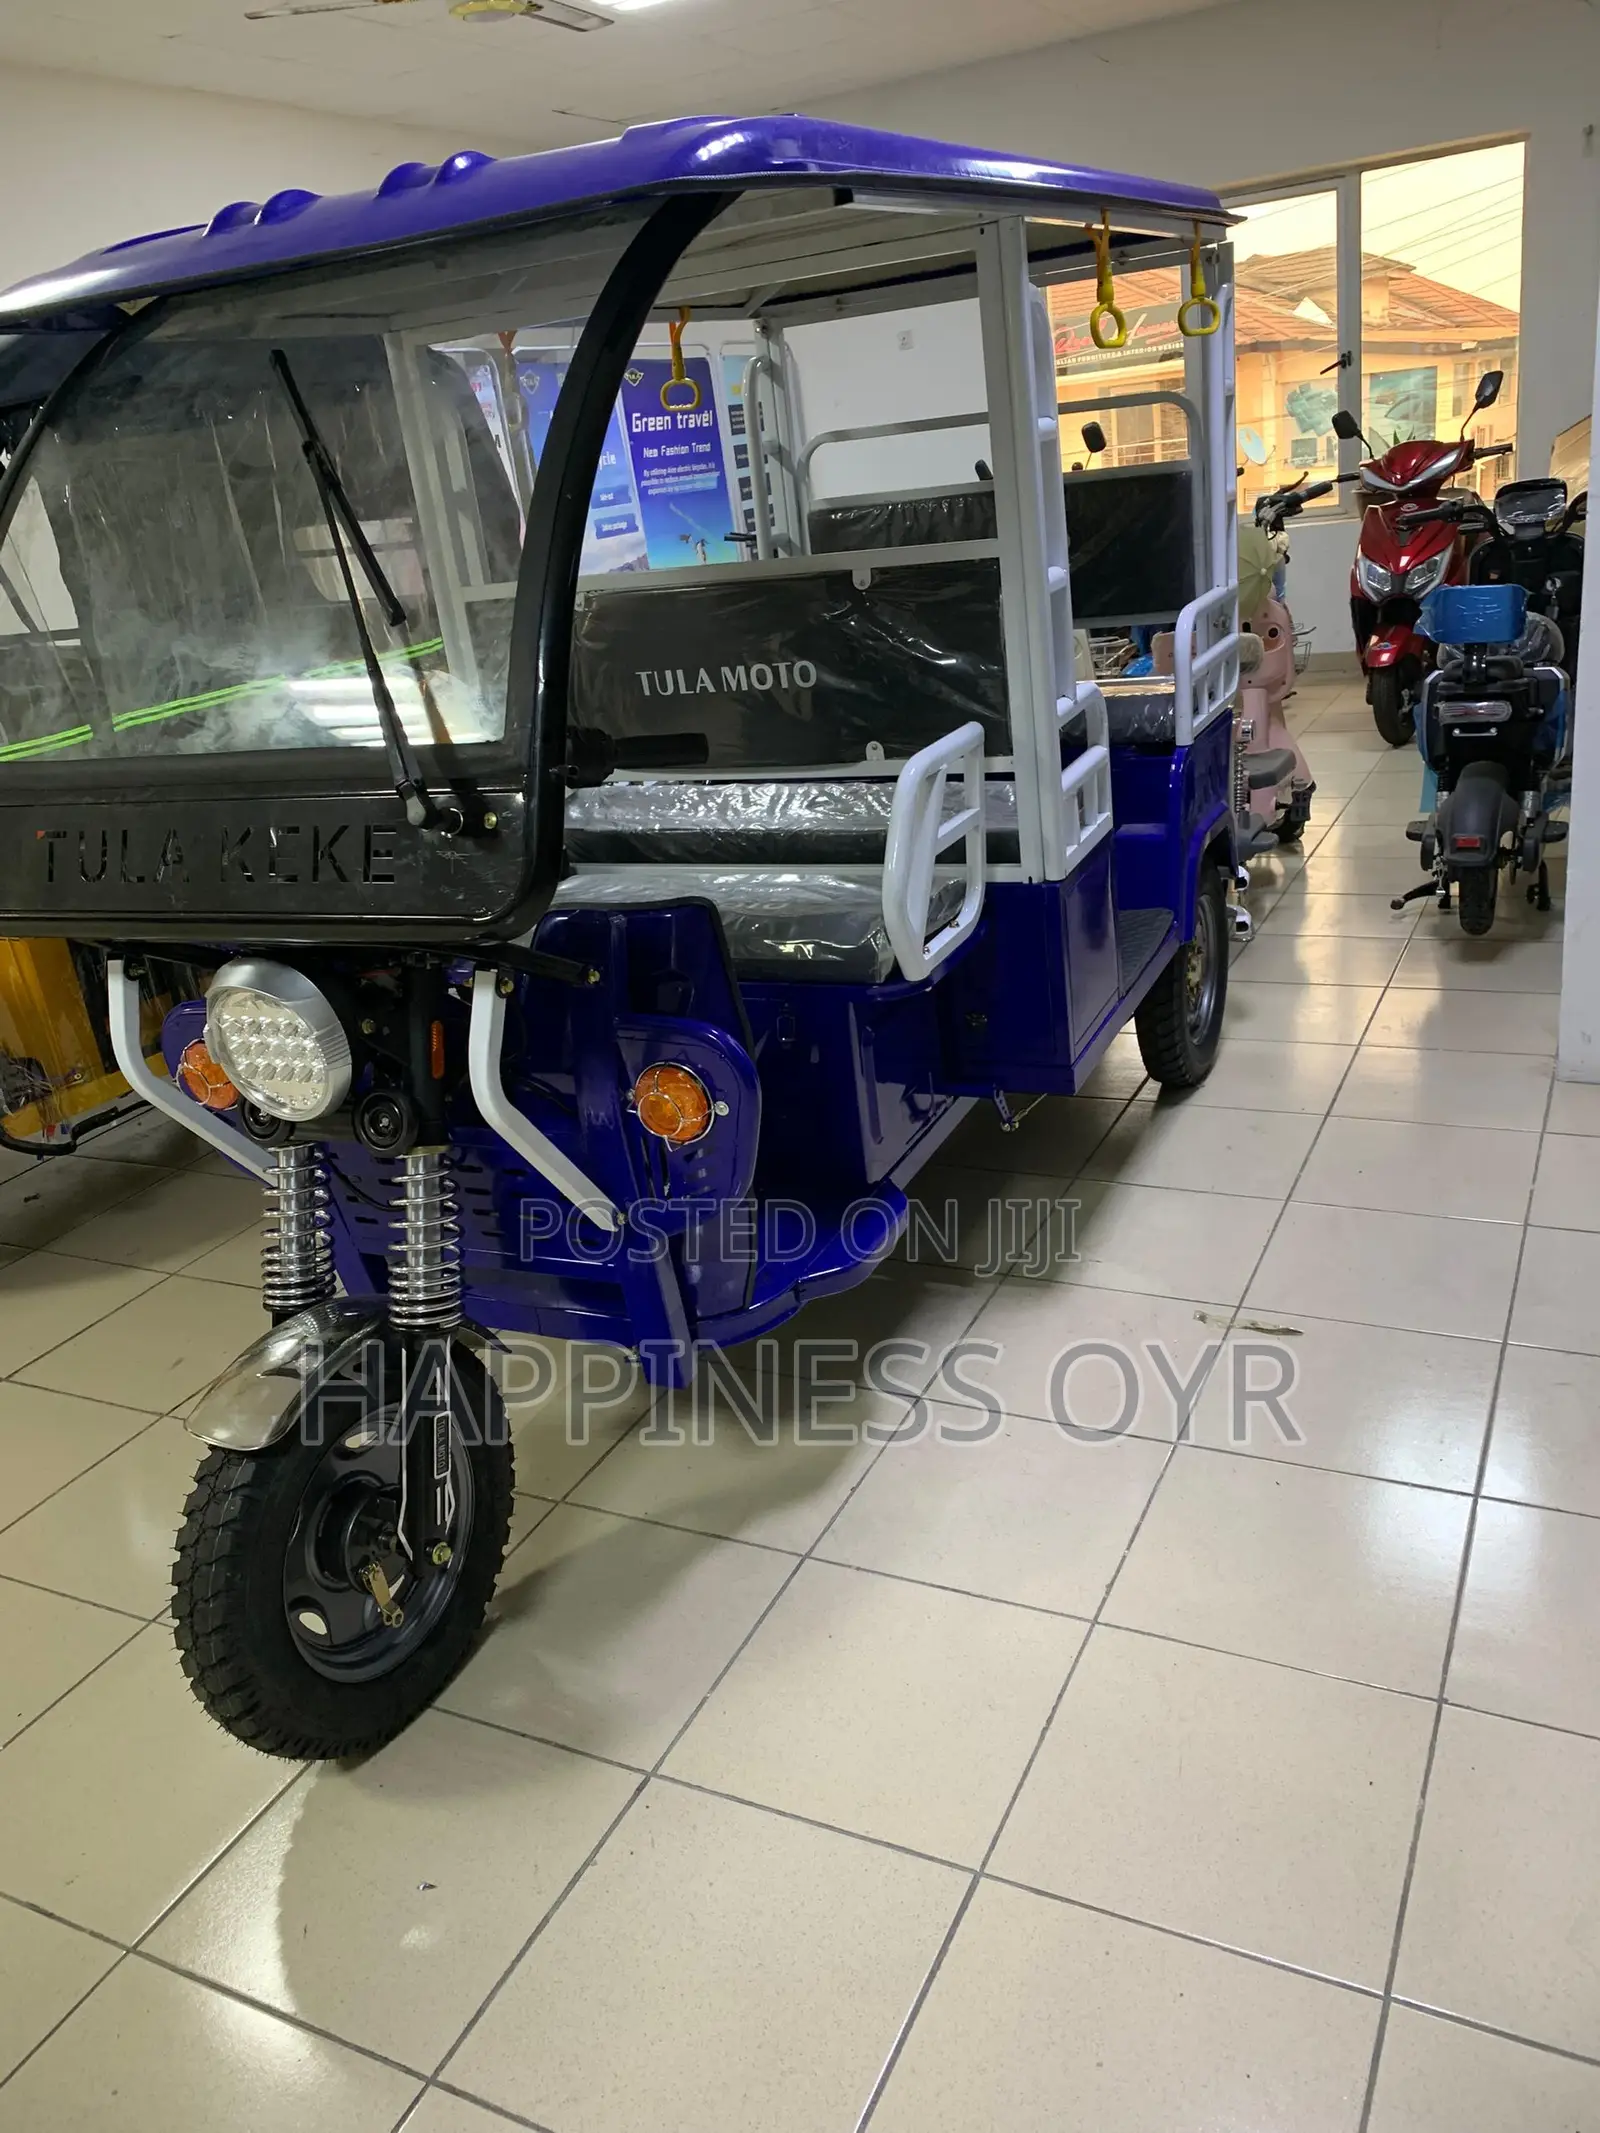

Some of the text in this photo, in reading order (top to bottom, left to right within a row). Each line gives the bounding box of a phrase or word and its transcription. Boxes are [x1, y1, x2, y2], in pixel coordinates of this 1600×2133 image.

[632, 412, 672, 433] Green
[676, 409, 713, 429] travel
[660, 444, 690, 456] Fashion
[691, 441, 711, 453] Trend
[635, 660, 817, 696] TULA MOTO
[36, 824, 398, 885] TULA KEKE
